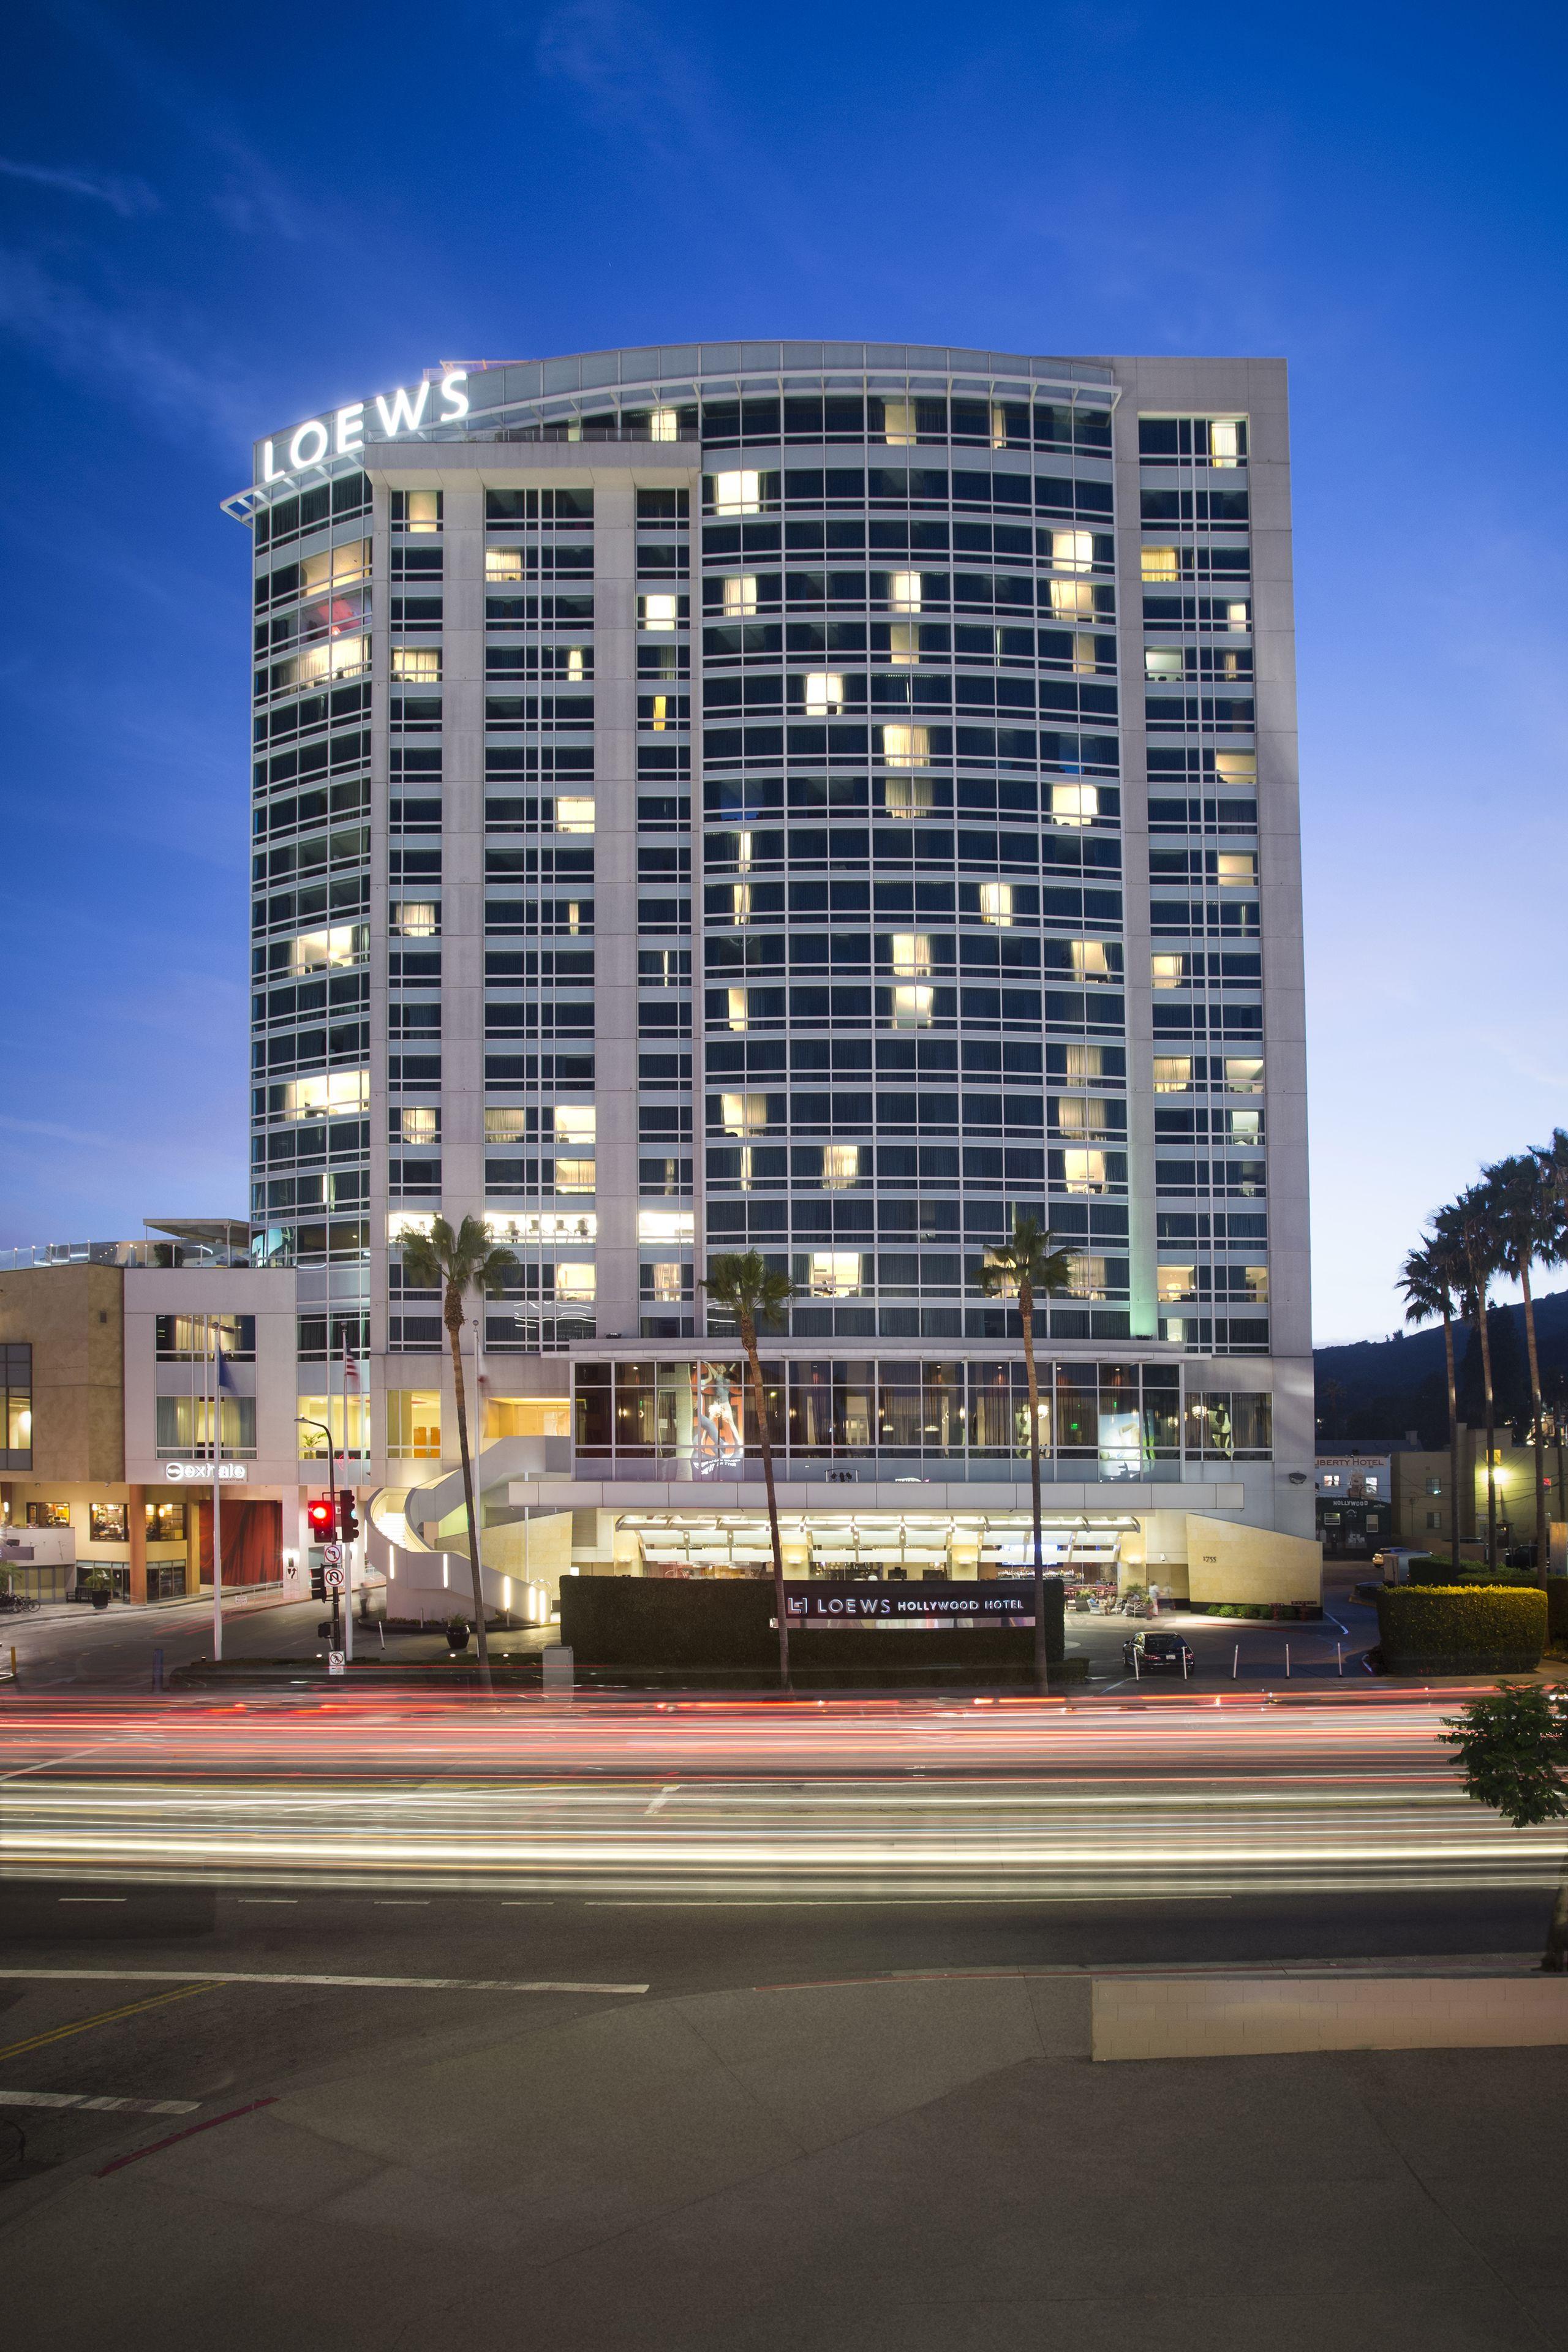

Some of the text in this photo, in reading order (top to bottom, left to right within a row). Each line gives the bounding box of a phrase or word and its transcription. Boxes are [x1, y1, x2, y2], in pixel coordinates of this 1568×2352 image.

[263, 371, 470, 482] LOEWS
[183, 1463, 246, 1478] exhale
[818, 1599, 891, 1614] LOEWS
[897, 1600, 979, 1611] HOLLYWOOD
[984, 1600, 1024, 1610] HOTEL
